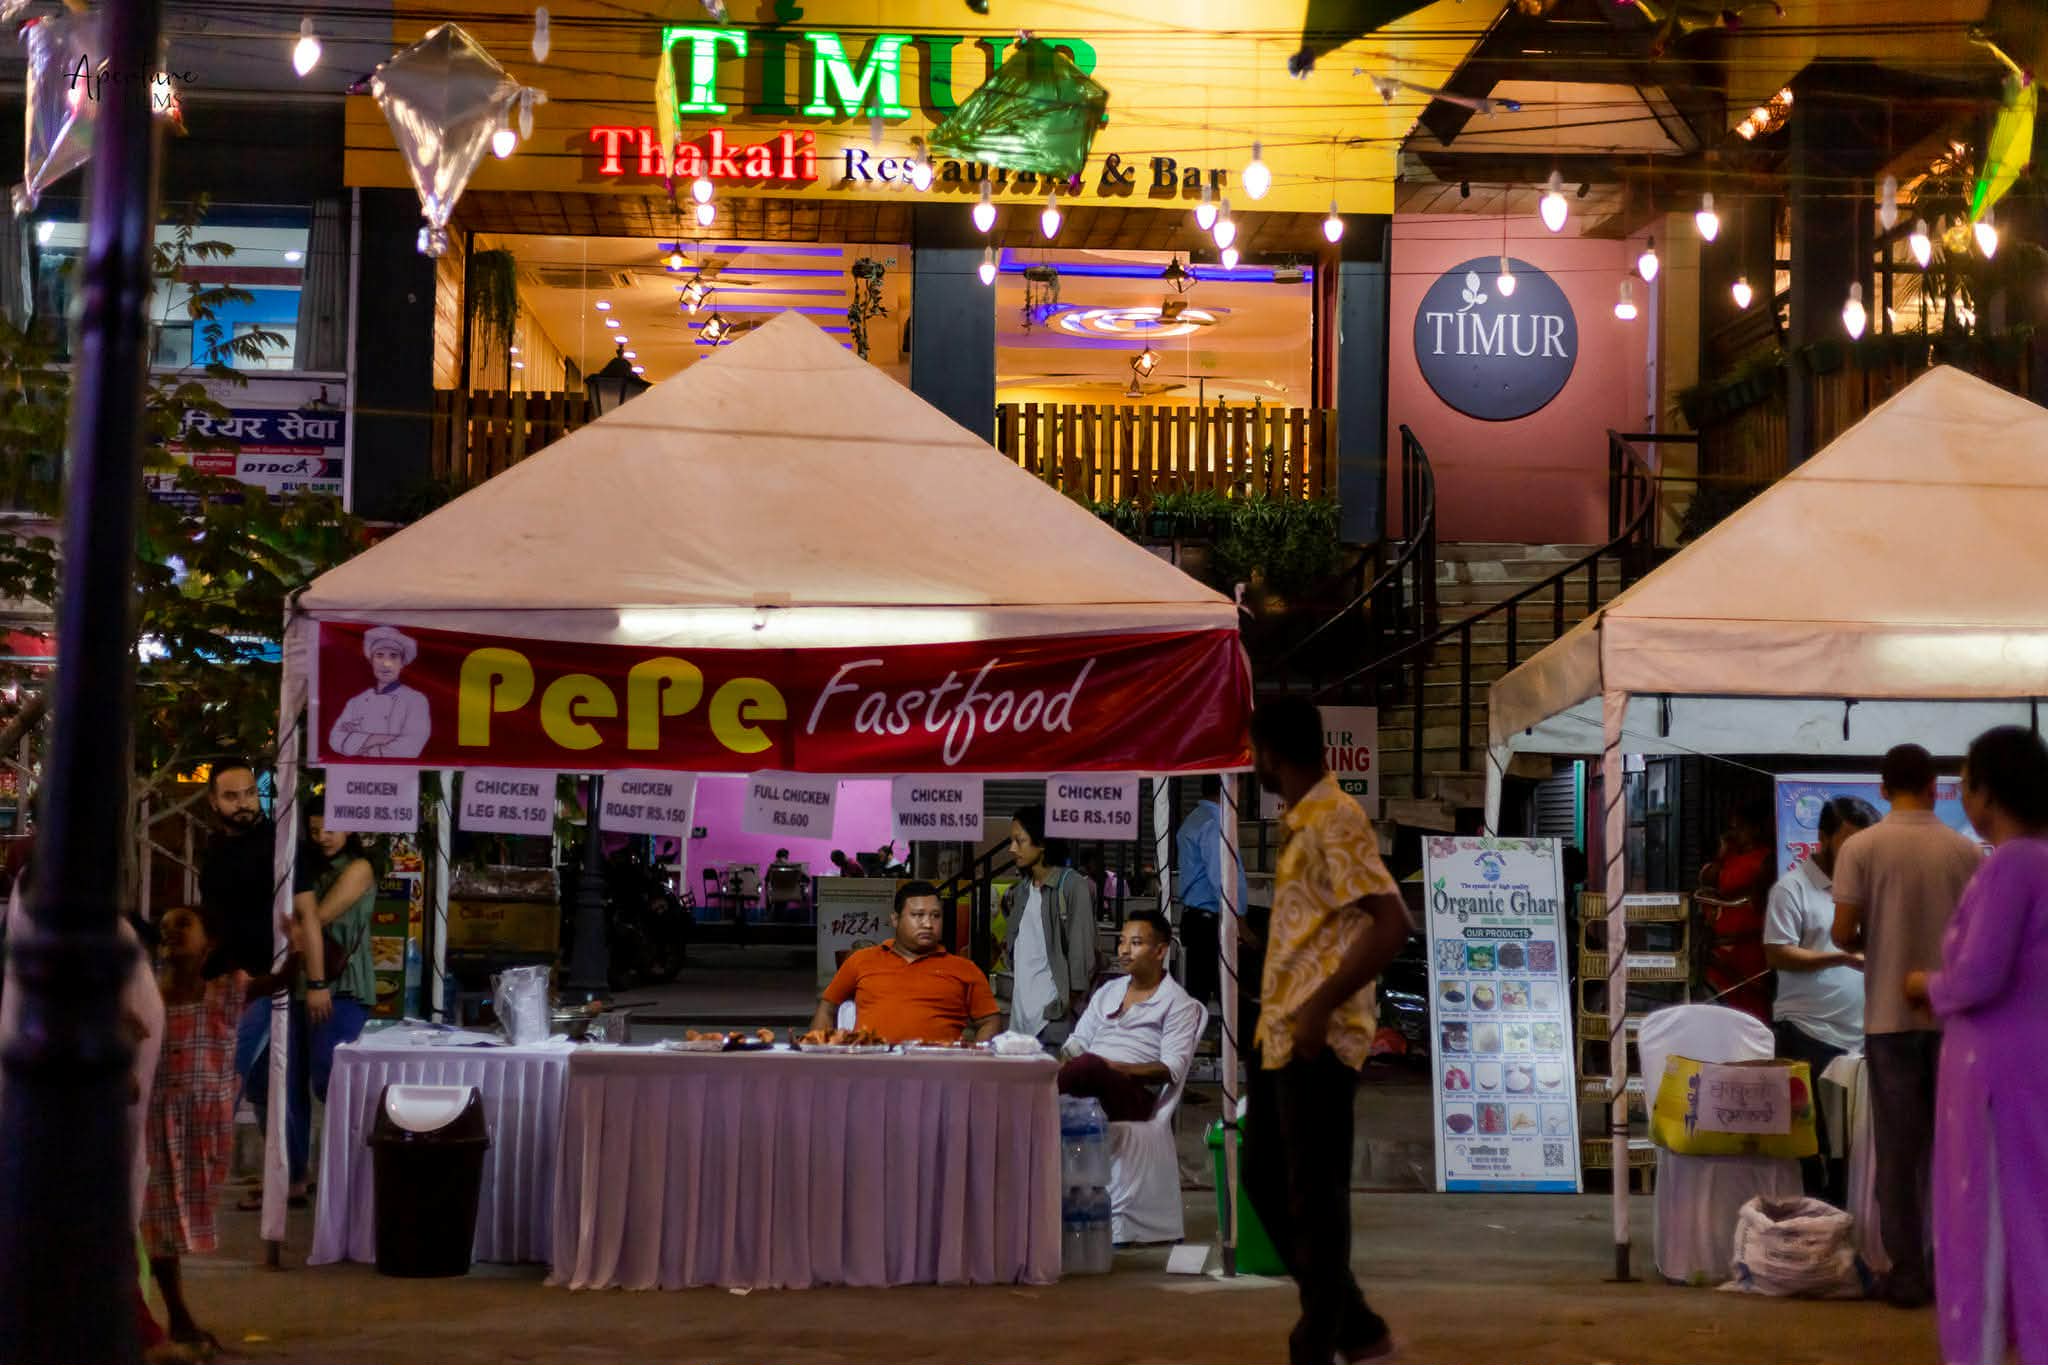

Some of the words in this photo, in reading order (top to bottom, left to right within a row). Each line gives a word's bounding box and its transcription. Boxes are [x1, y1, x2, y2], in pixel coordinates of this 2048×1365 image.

[589, 125, 819, 180] Thakali
[841, 147, 1085, 187] Restaura
[1101, 153, 1136, 188] &
[1150, 157, 1227, 190] Bar
[1426, 311, 1568, 358] TIMUR
[277, 413, 340, 441] सेवा
[243, 462, 295, 474] DTDC
[807, 658, 1096, 767] Fastfood
[346, 782, 398, 797] CHICKEN
[475, 780, 540, 798] CHICKEN
[621, 781, 673, 798] CHICKEN
[753, 784, 780, 801] FULL
[782, 787, 830, 806] CHICKEN
[911, 788, 963, 803] CHICKEN
[1058, 784, 1123, 801] CHICKEN
[333, 806, 371, 821] WINGS
[373, 806, 413, 822] RS.150
[466, 804, 495, 820] LEG
[498, 805, 547, 824] RS.150
[606, 802, 644, 820] ROAST
[647, 805, 686, 824] RS.150
[772, 811, 809, 829] RS.600
[898, 812, 937, 828] WINGS
[939, 812, 979, 829] RS.150
[1052, 808, 1079, 824] LEG
[1082, 808, 1133, 826] RS.150
[1433, 889, 1505, 923] Organic
[1511, 891, 1557, 916] Ghar
[832, 917, 880, 936] PIZZA
[1466, 928, 1484, 938] OUR
[1485, 928, 1530, 938] PRODUCTS
